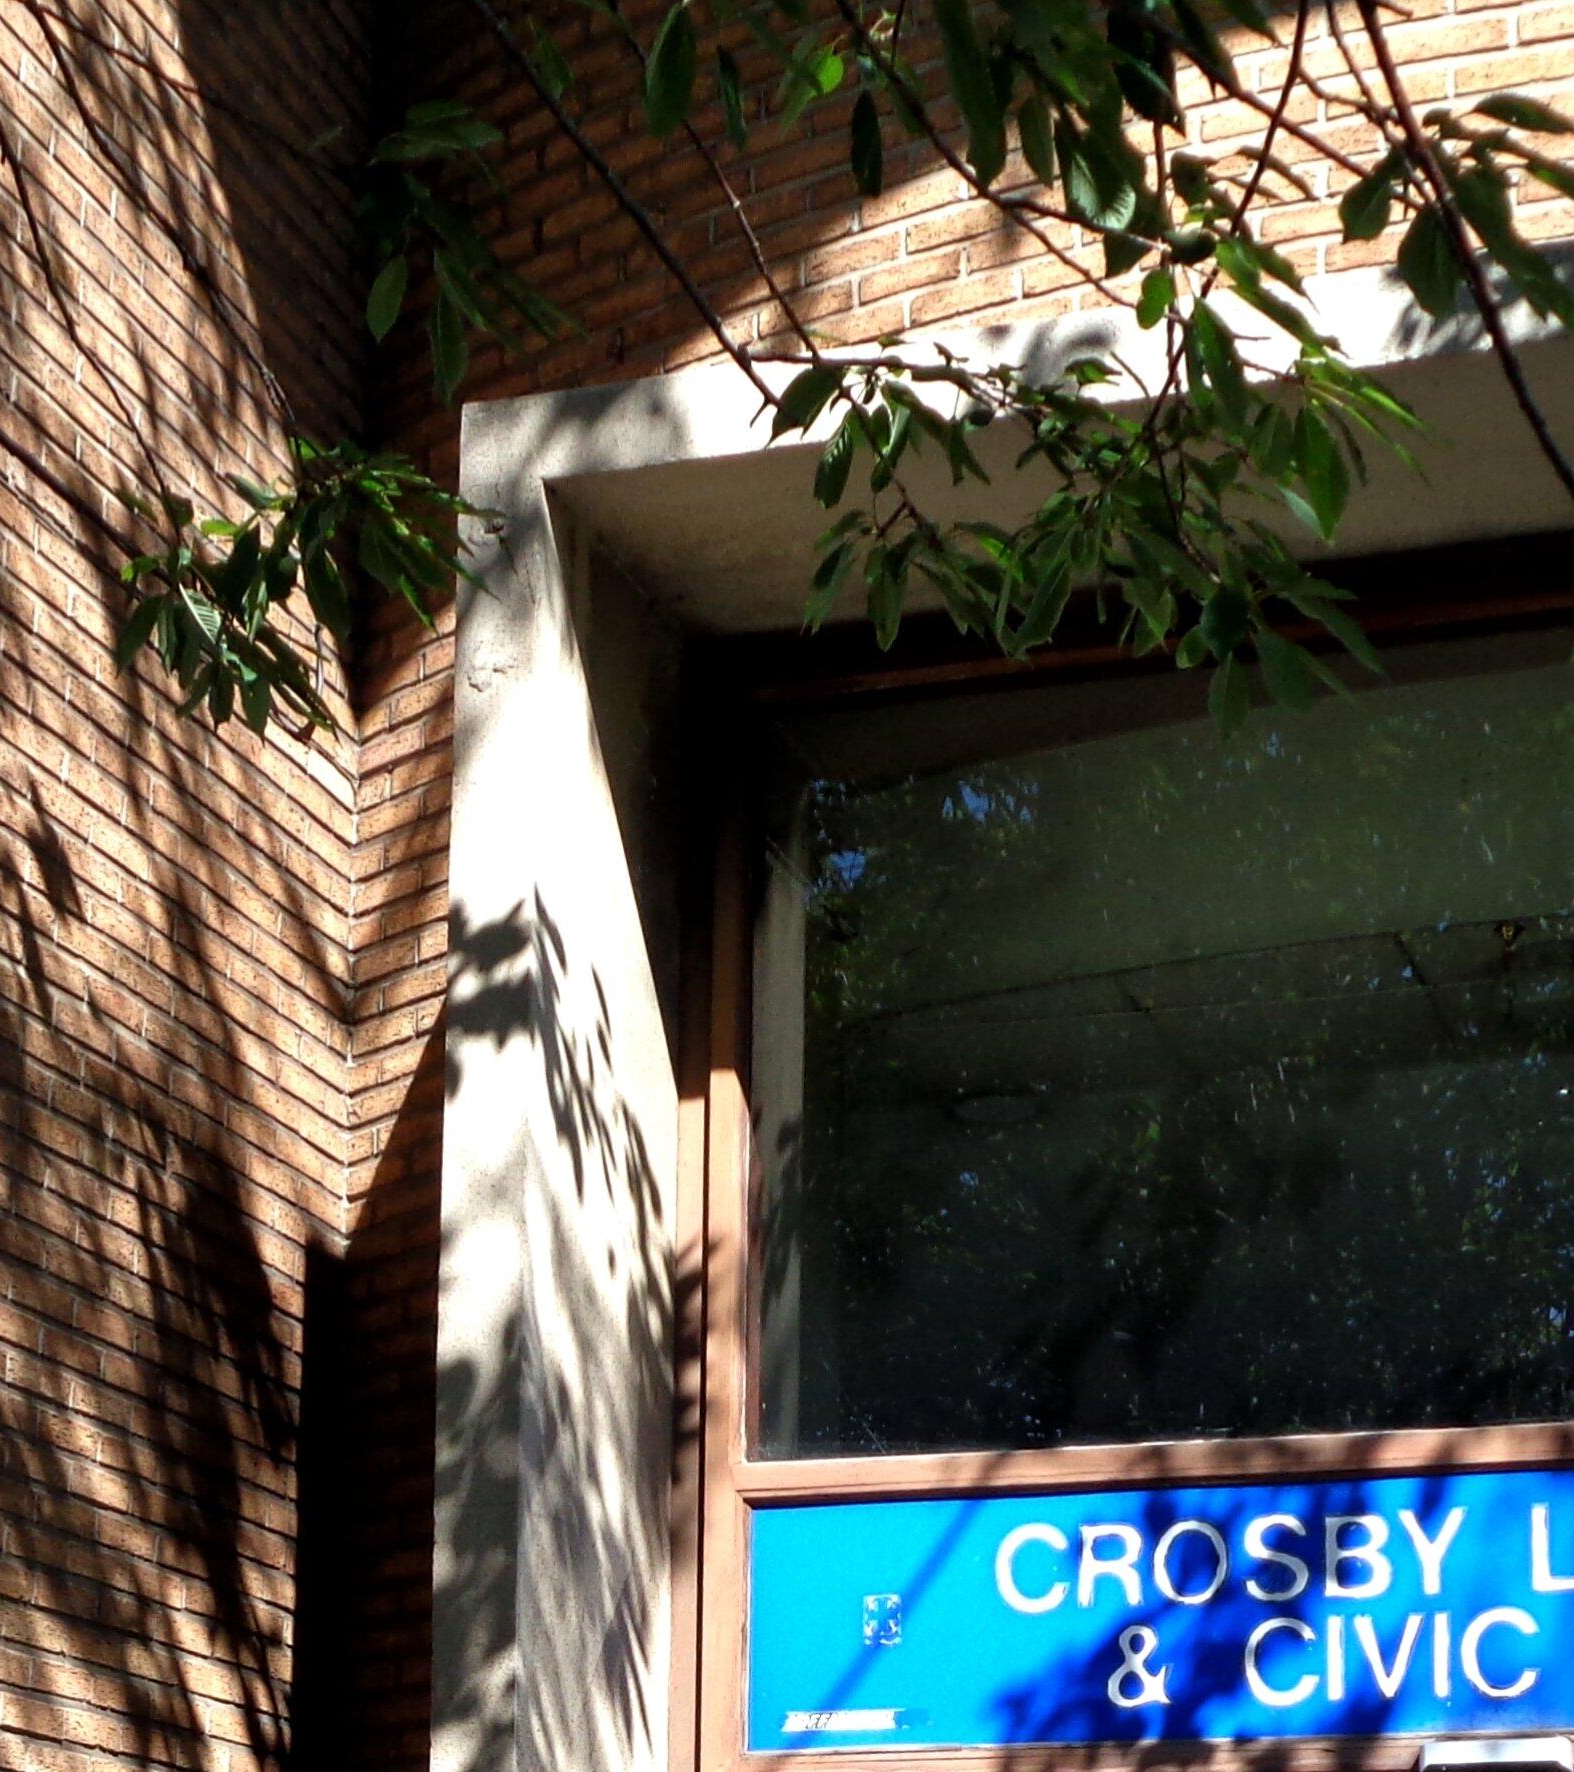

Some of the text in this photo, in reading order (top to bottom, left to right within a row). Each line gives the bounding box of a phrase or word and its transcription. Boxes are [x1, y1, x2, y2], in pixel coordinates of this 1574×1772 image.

[995, 1506, 1467, 1613] CROSBY
[1108, 1624, 1172, 1707] &
[1244, 1607, 1541, 1706] CIVIC
